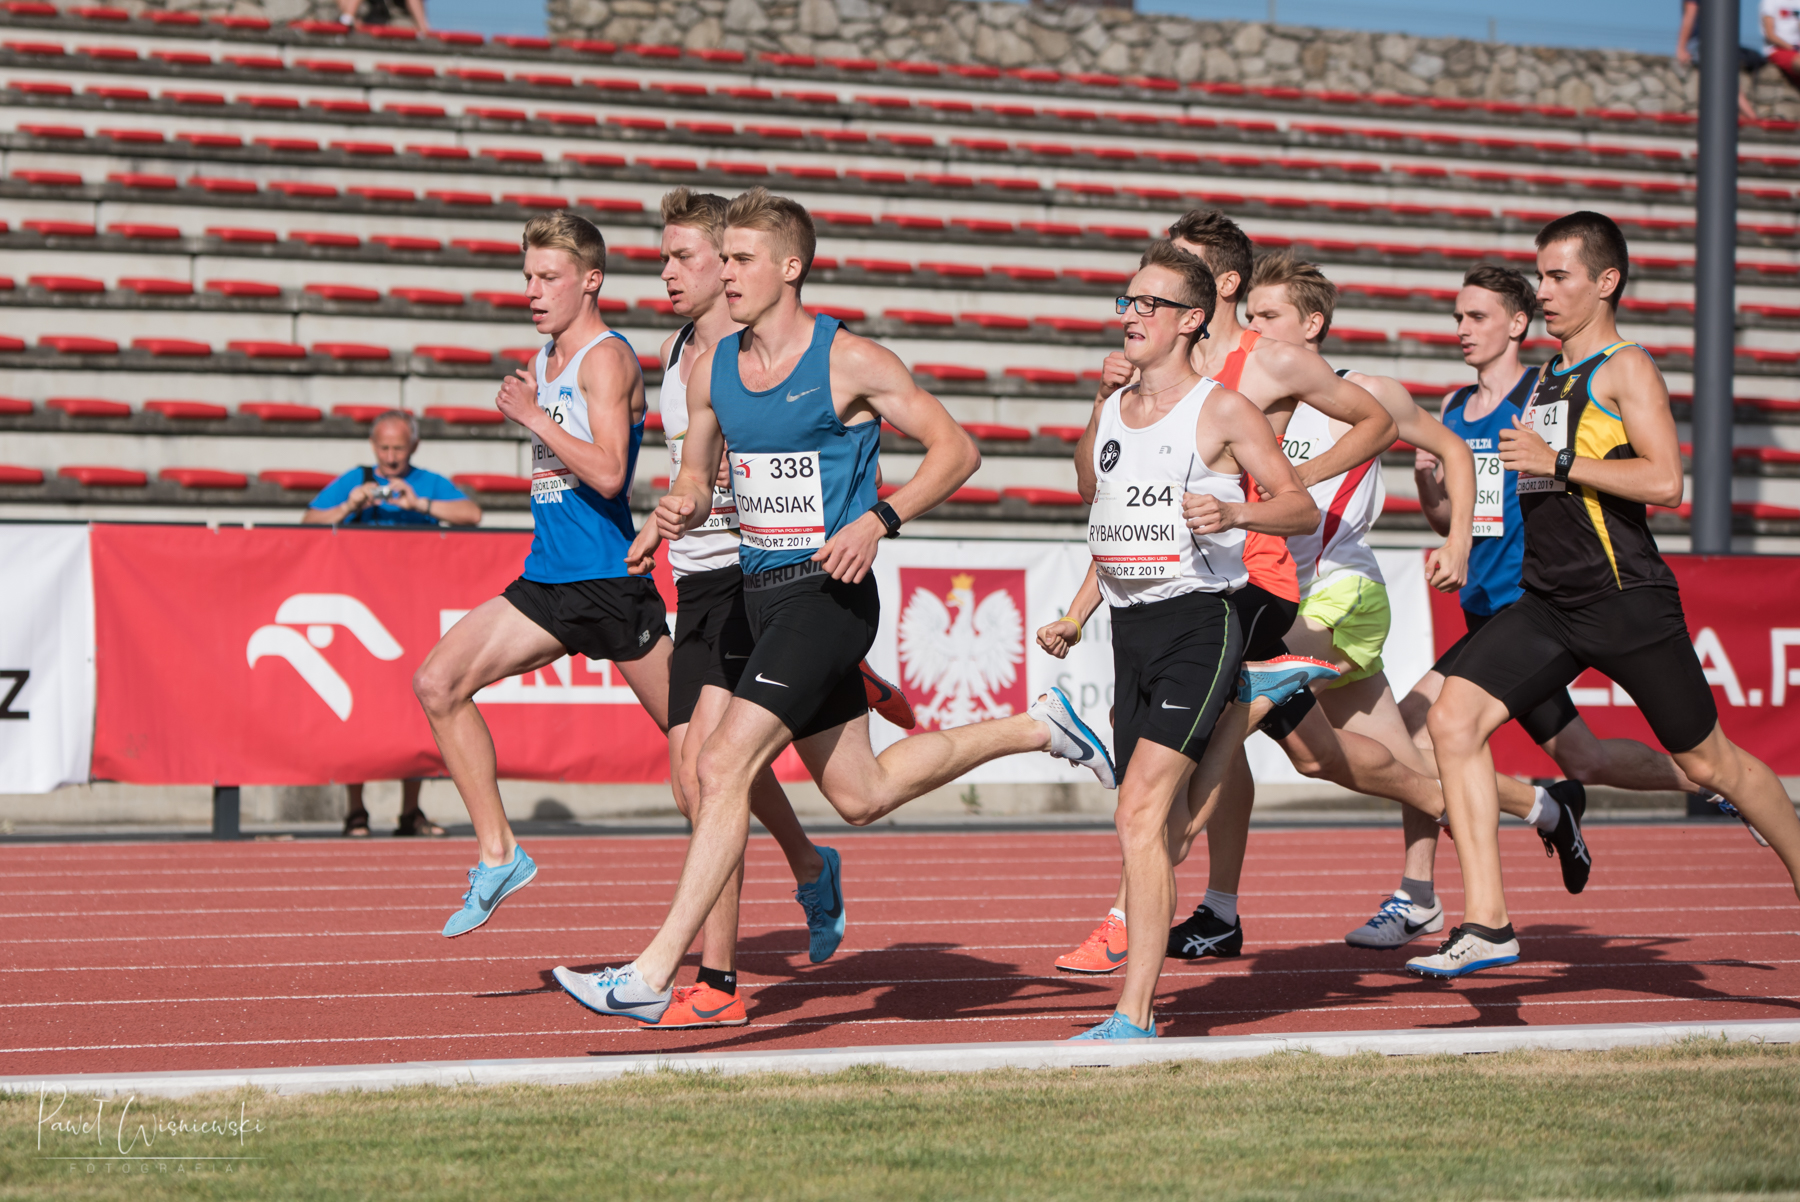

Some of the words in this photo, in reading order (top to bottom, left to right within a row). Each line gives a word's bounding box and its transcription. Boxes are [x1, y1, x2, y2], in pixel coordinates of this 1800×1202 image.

[1543, 405, 1558, 426] 61
[1282, 439, 1311, 460] 702
[770, 456, 814, 479] 338
[1477, 457, 1500, 475] 78
[550, 478, 567, 489] 2019
[1538, 480, 1554, 489] 2019
[736, 493, 816, 514] TOMASIAK
[1126, 485, 1174, 507] 264
[708, 516, 731, 528] 2019
[787, 536, 811, 547] 2019
[1089, 524, 1175, 542] RYBAKOWSKI
[762, 566, 795, 587] PRO
[1138, 565, 1165, 576] 2019
